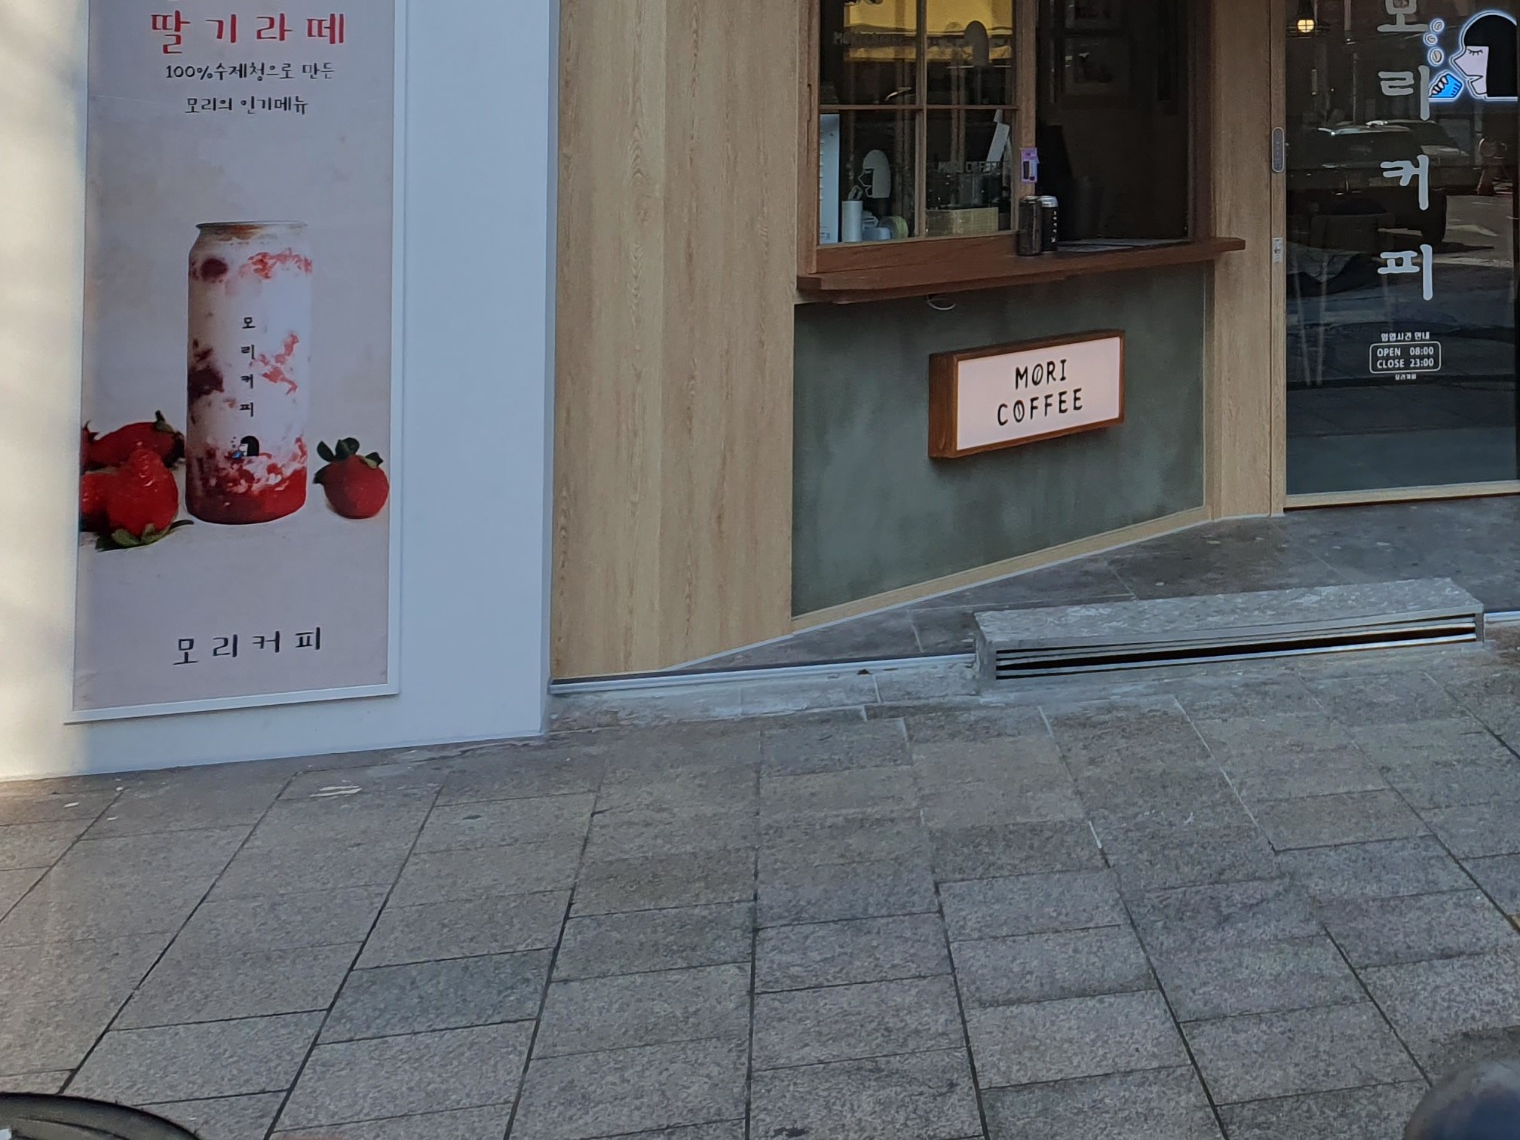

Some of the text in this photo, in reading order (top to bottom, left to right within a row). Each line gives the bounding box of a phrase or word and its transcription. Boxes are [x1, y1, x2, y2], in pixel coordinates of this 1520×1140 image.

[150, 10, 345, 54] 딸기라떼
[165, 62, 335, 82] 100%수제청으로 만든
[184, 95, 308, 115] 모리의 인기메뉴
[240, 316, 255, 417] 모리커피
[1377, 346, 1434, 357] OPEN 08:00
[1377, 357, 1434, 369] CLOSE 23:00
[1015, 359, 1067, 390] MORI
[997, 388, 1083, 426] COFFEE
[172, 627, 322, 666] 모리커피
